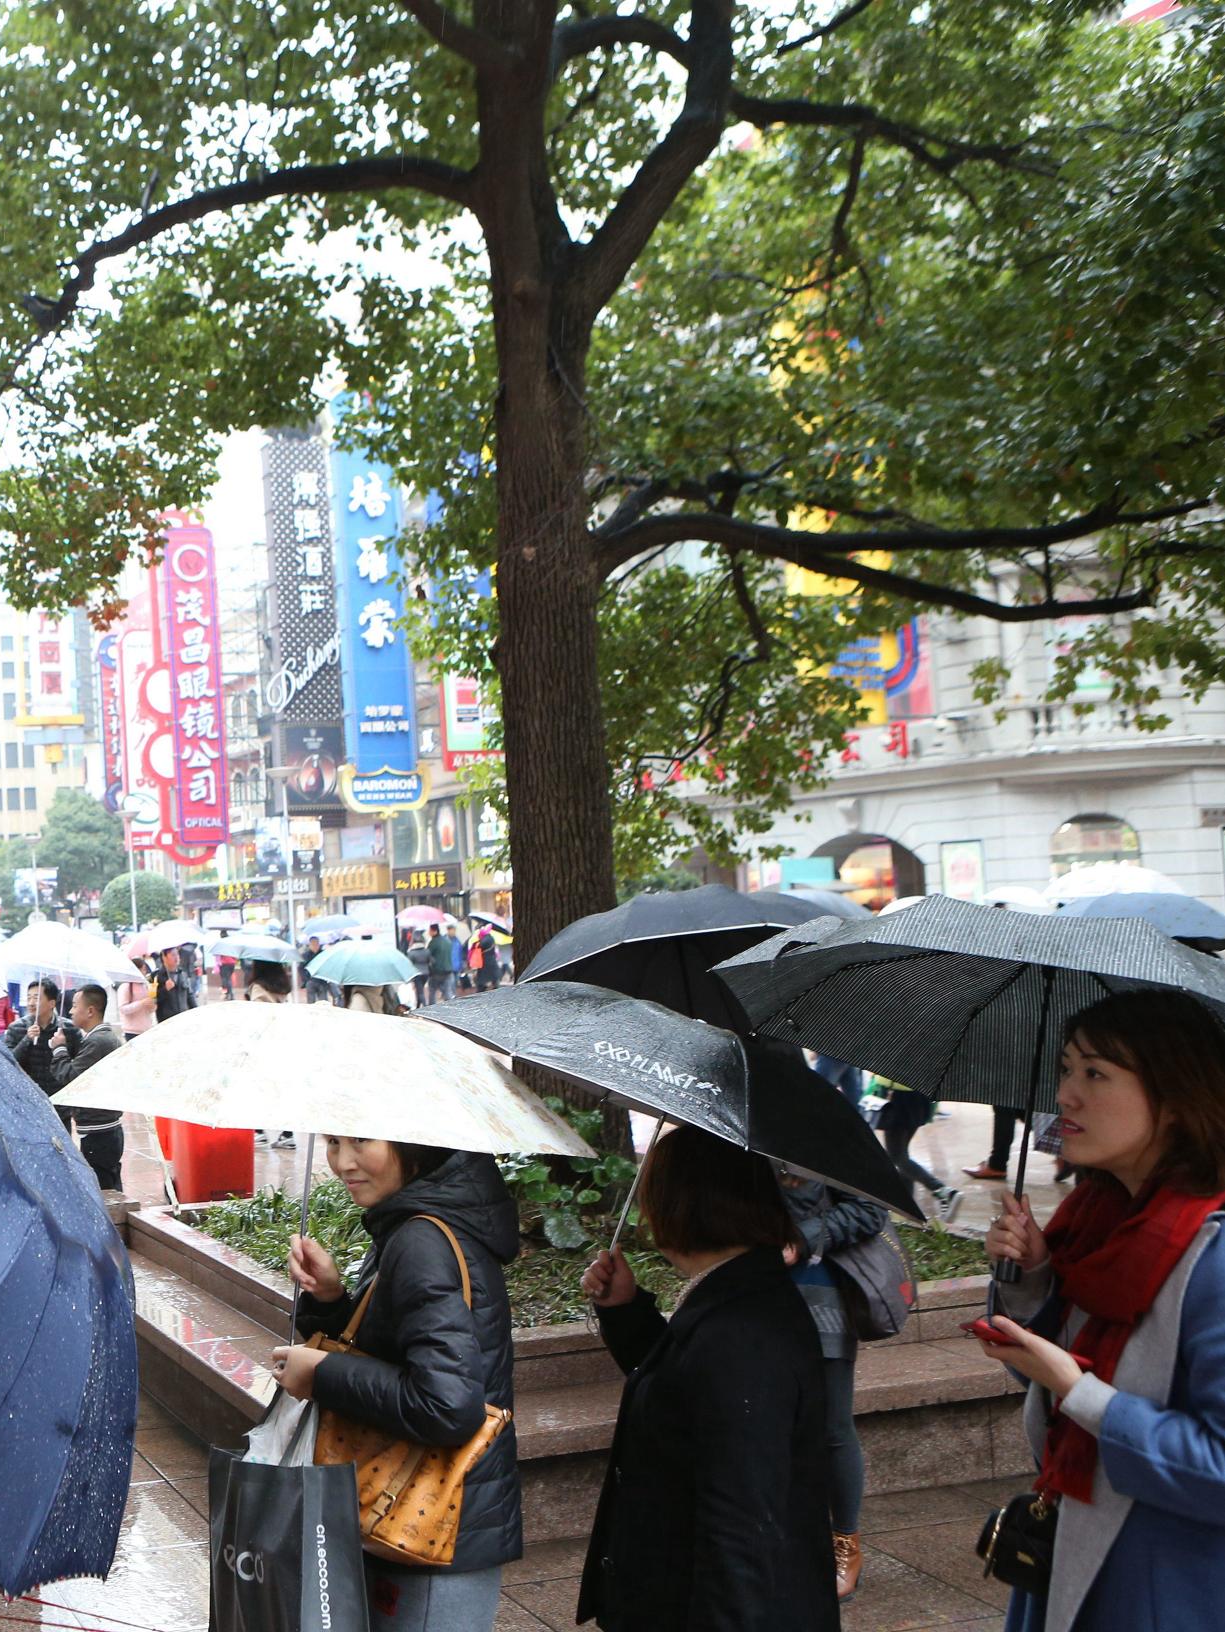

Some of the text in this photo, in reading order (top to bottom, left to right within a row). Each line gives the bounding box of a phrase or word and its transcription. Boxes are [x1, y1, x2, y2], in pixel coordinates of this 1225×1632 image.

[174, 588, 221, 806] 茂昌眼镜公司
[184, 816, 223, 829] OPTICAL
[316, 1523, 332, 1630] cn.ecco.com
